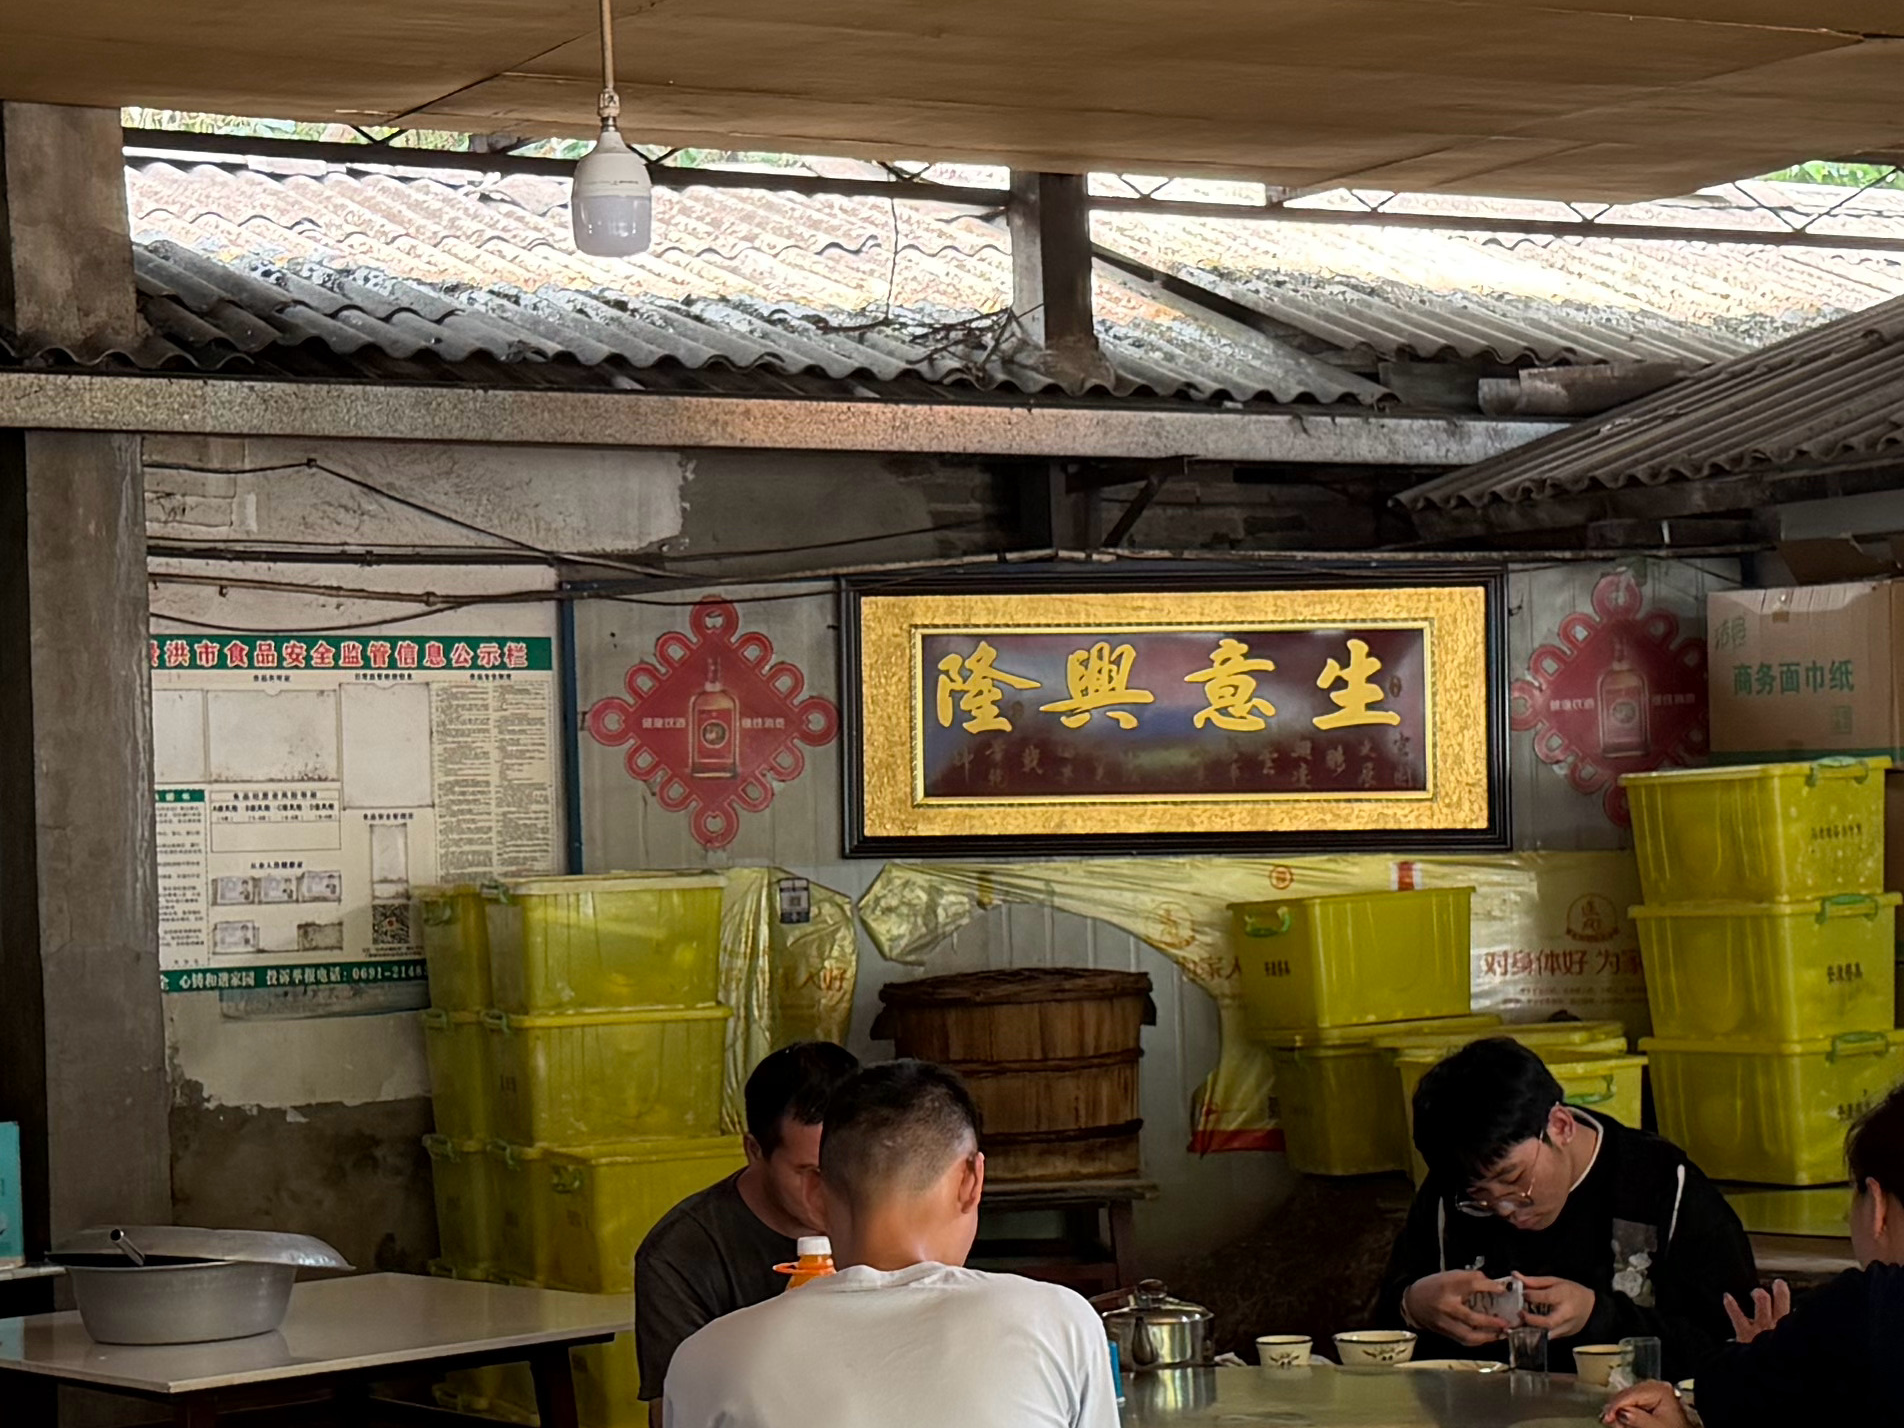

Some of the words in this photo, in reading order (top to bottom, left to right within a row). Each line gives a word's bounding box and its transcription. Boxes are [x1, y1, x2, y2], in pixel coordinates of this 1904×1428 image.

[1733, 660, 1855, 696] 商务面巾纸
